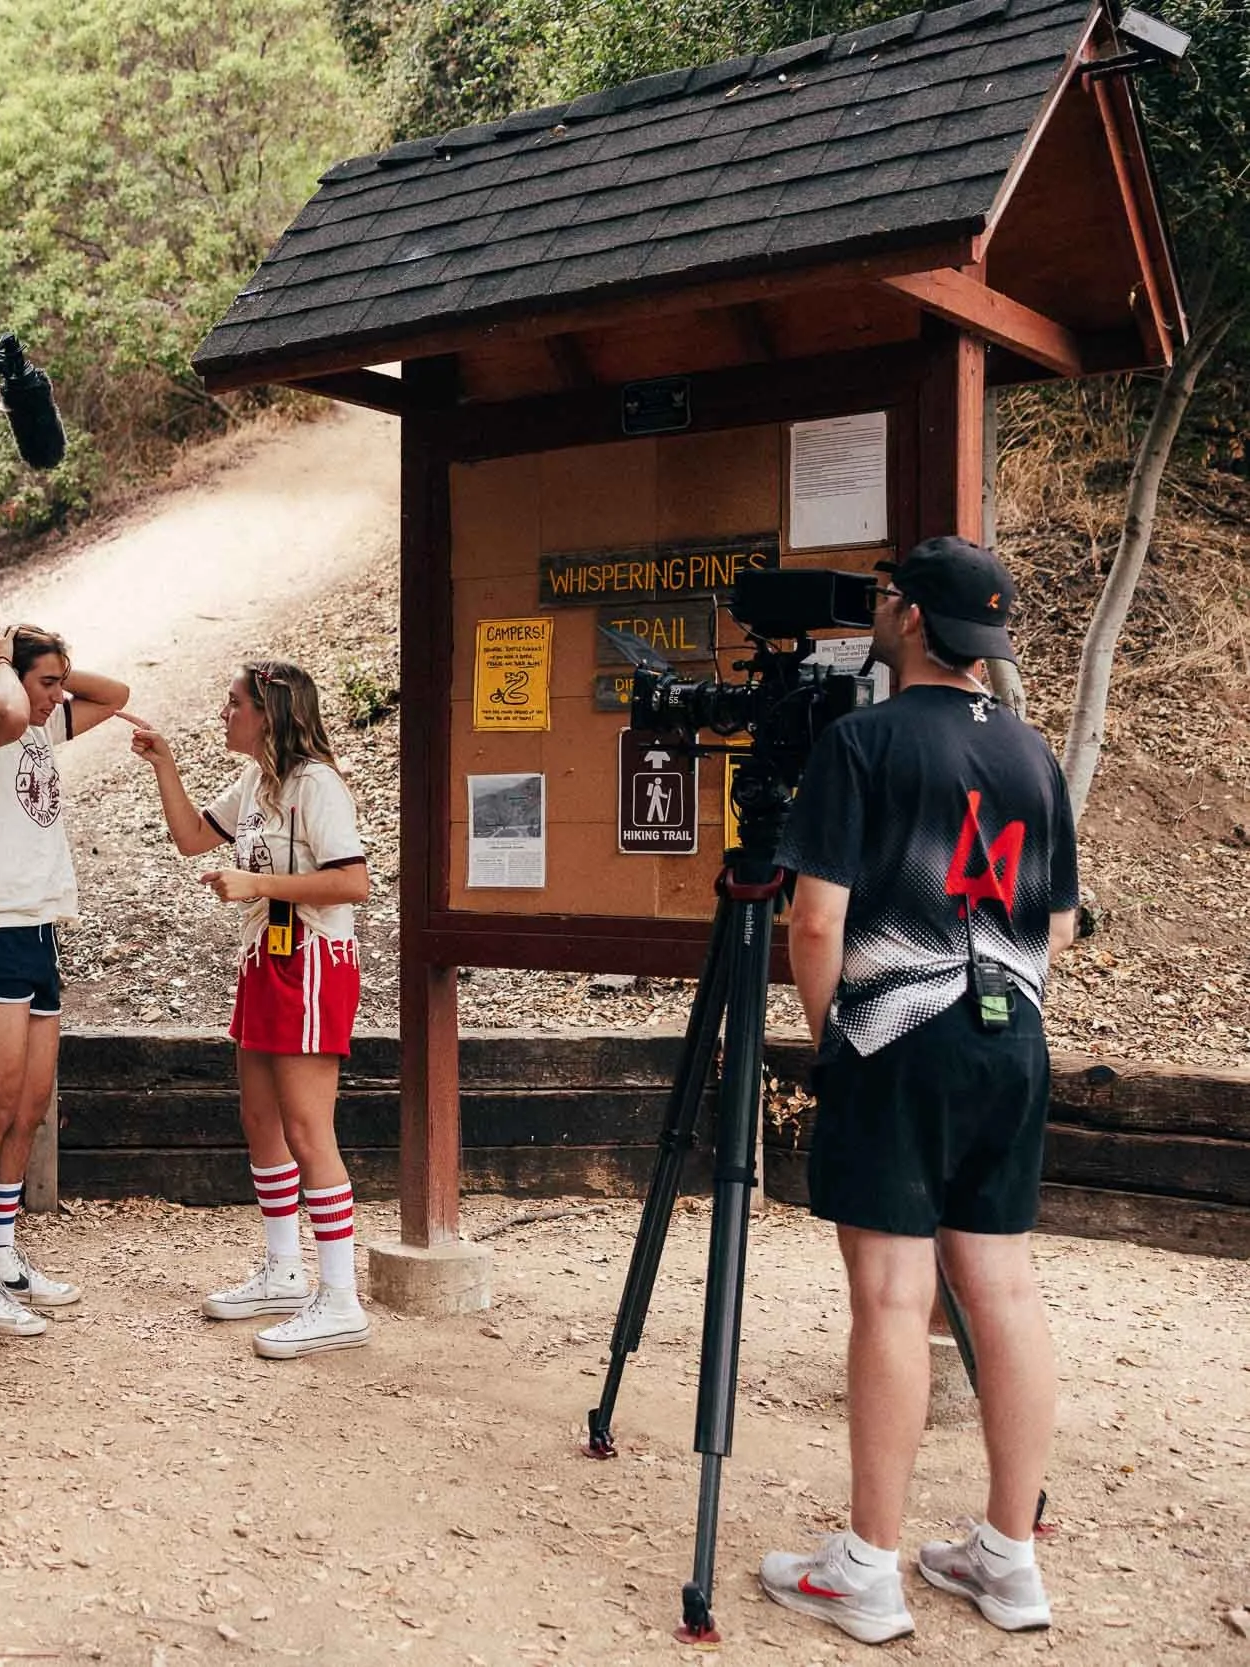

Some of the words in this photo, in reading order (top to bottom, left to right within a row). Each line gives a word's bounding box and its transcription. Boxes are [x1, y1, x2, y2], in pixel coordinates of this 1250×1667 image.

[549, 558, 685, 594] WHISPERING
[486, 624, 546, 641] CAMPERS!
[670, 687, 681, 695] 20
[669, 696, 679, 704] 55
[623, 830, 660, 841] HIKING
[662, 830, 692, 841] TRAIL
